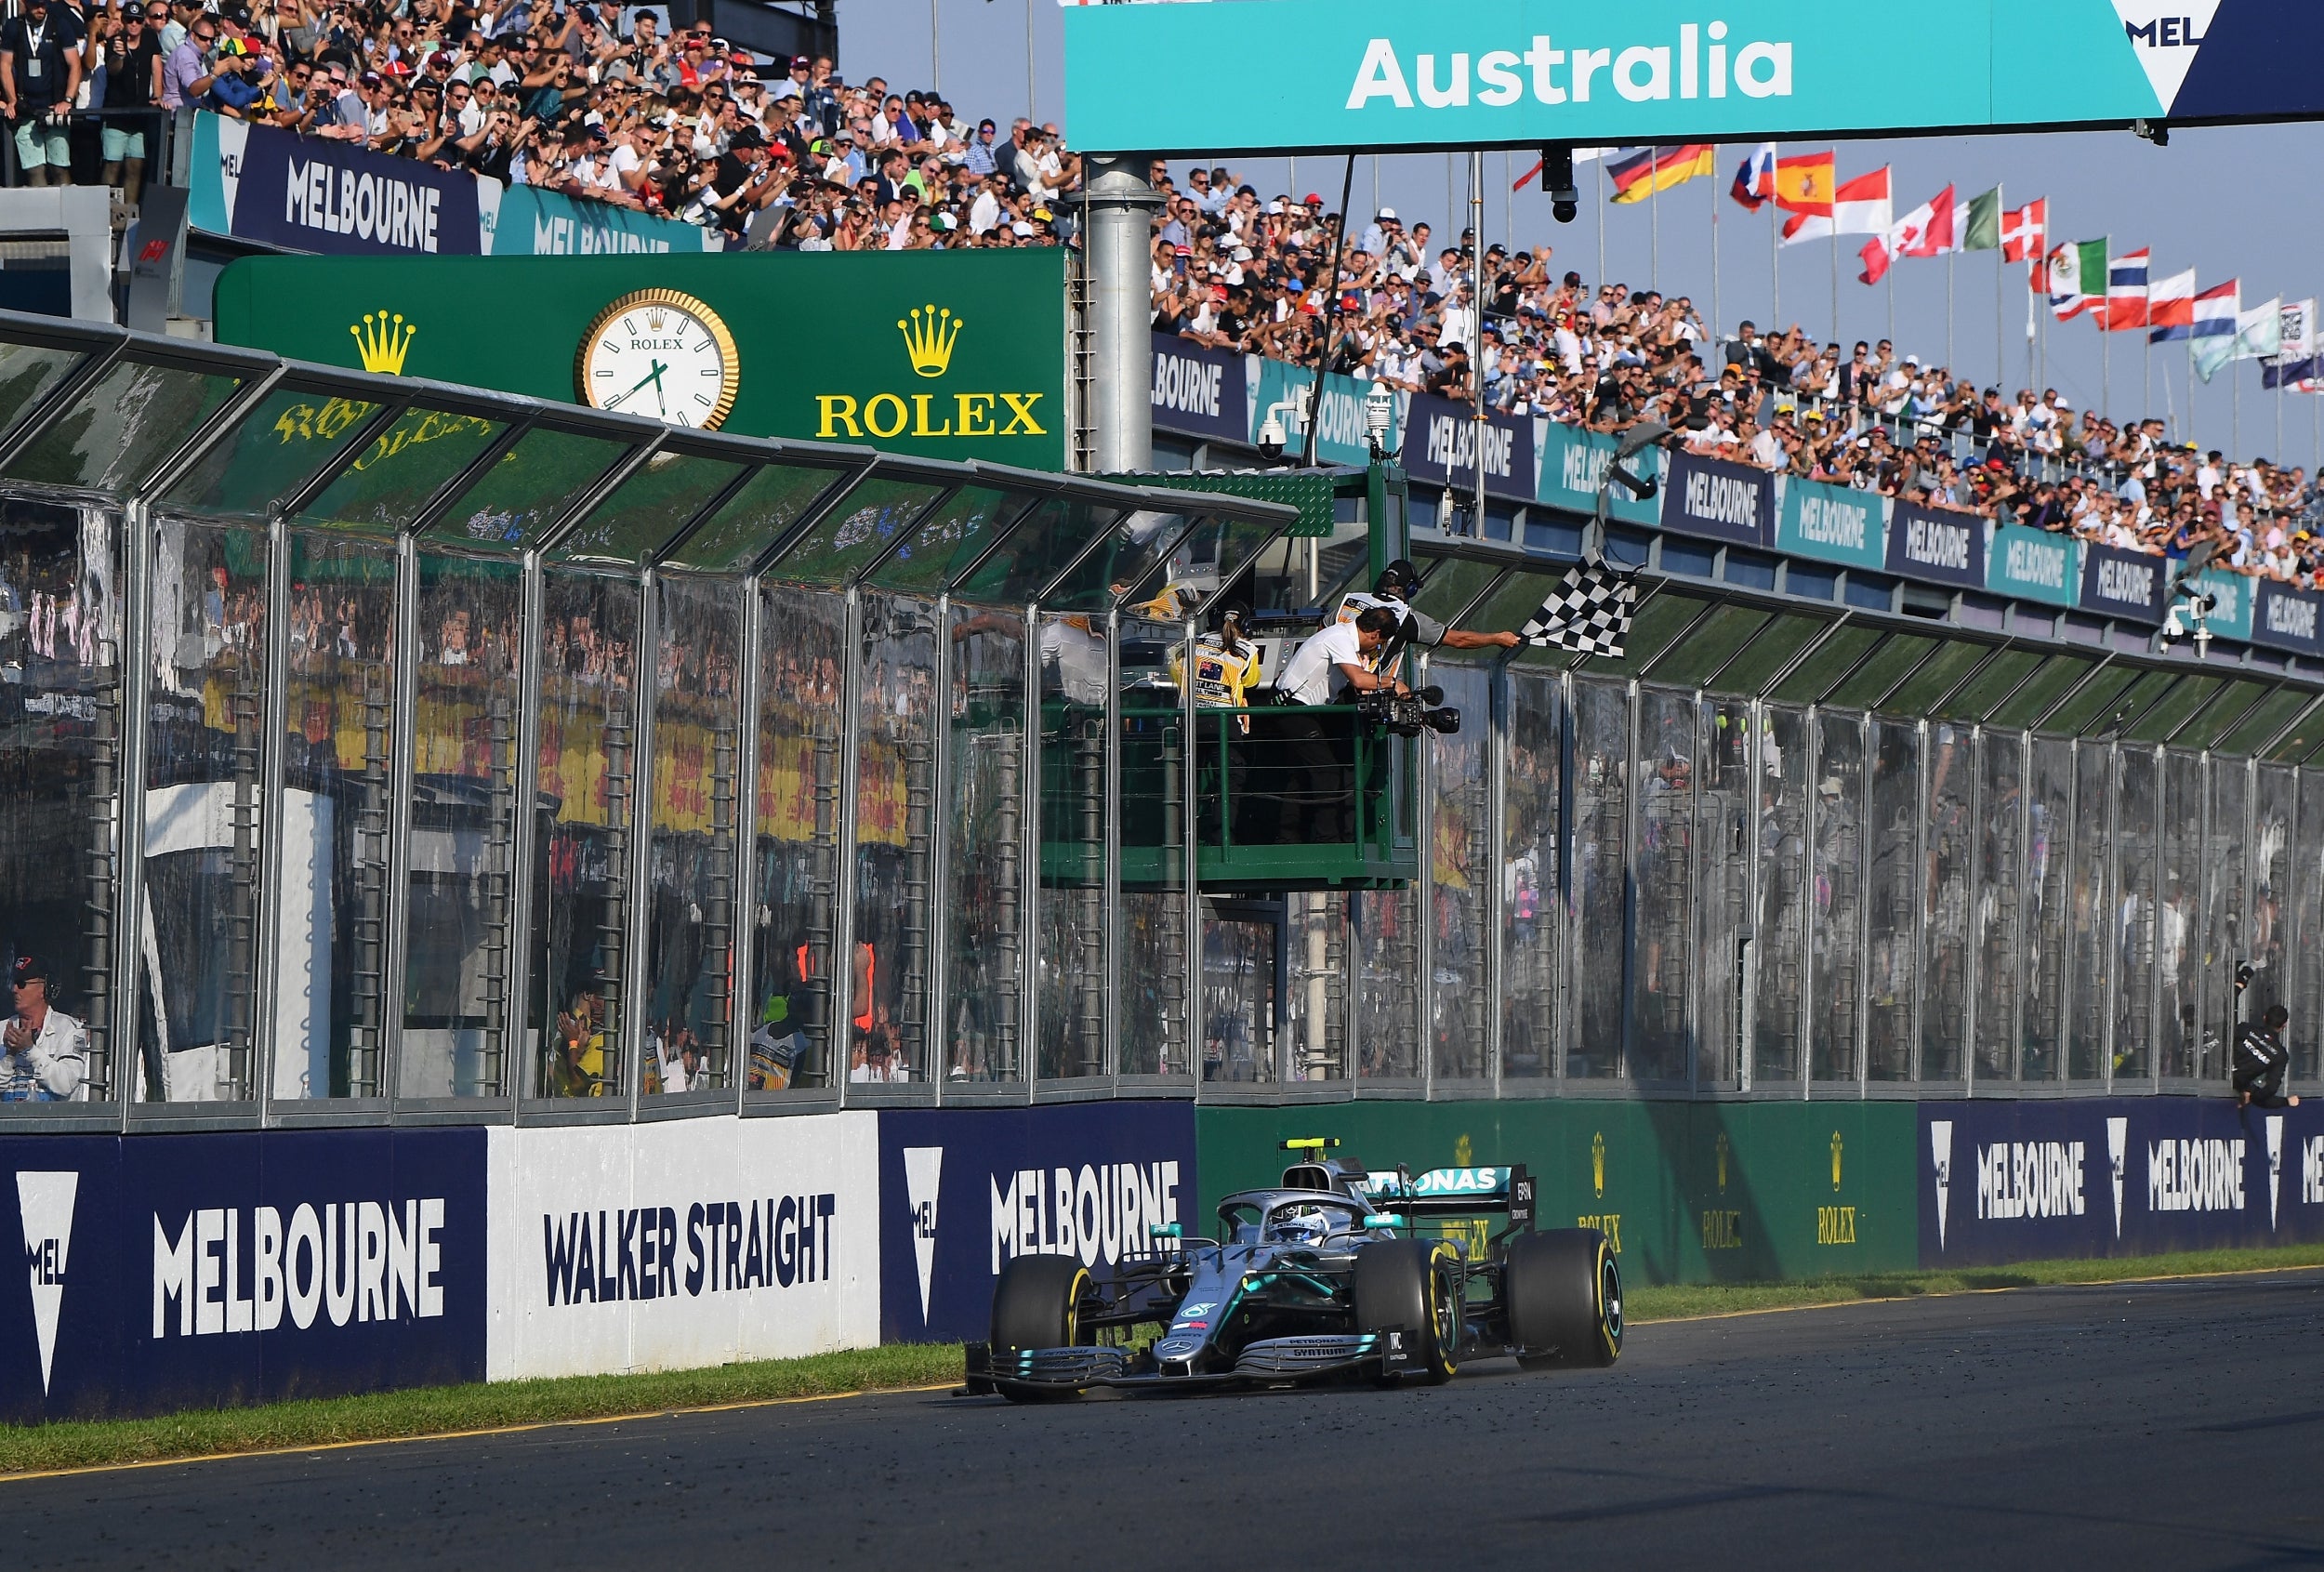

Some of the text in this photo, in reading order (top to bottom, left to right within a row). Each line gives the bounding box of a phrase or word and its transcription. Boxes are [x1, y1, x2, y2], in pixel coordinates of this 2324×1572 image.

[2126, 17, 2204, 46] MEL
[1345, 20, 1792, 110] Australia
[220, 154, 240, 178] MEL
[286, 154, 441, 253] MELBOURNE
[631, 339, 683, 350] ROLEX
[1151, 352, 1222, 416] BOURNE
[815, 393, 1047, 438] ROLEX
[1427, 412, 1513, 477] MELBORNE
[1684, 469, 1759, 527] MELBOURNE
[1799, 495, 1867, 550] MELBOURNE
[1906, 517, 1970, 569] MELBOURNE
[1204, 682, 1225, 691] LANE
[1977, 1141, 2085, 1219] MELBOURNE
[2148, 1138, 2246, 1211] MELBOURNE
[910, 1200, 936, 1239] MEL
[991, 1160, 1181, 1275] MELBOURNE
[1817, 1207, 1855, 1244] ROLEX
[26, 1238, 65, 1286] MEL
[152, 1198, 445, 1339] MELBOURNE
[544, 1194, 835, 1307] WALKER STRAIGHT
